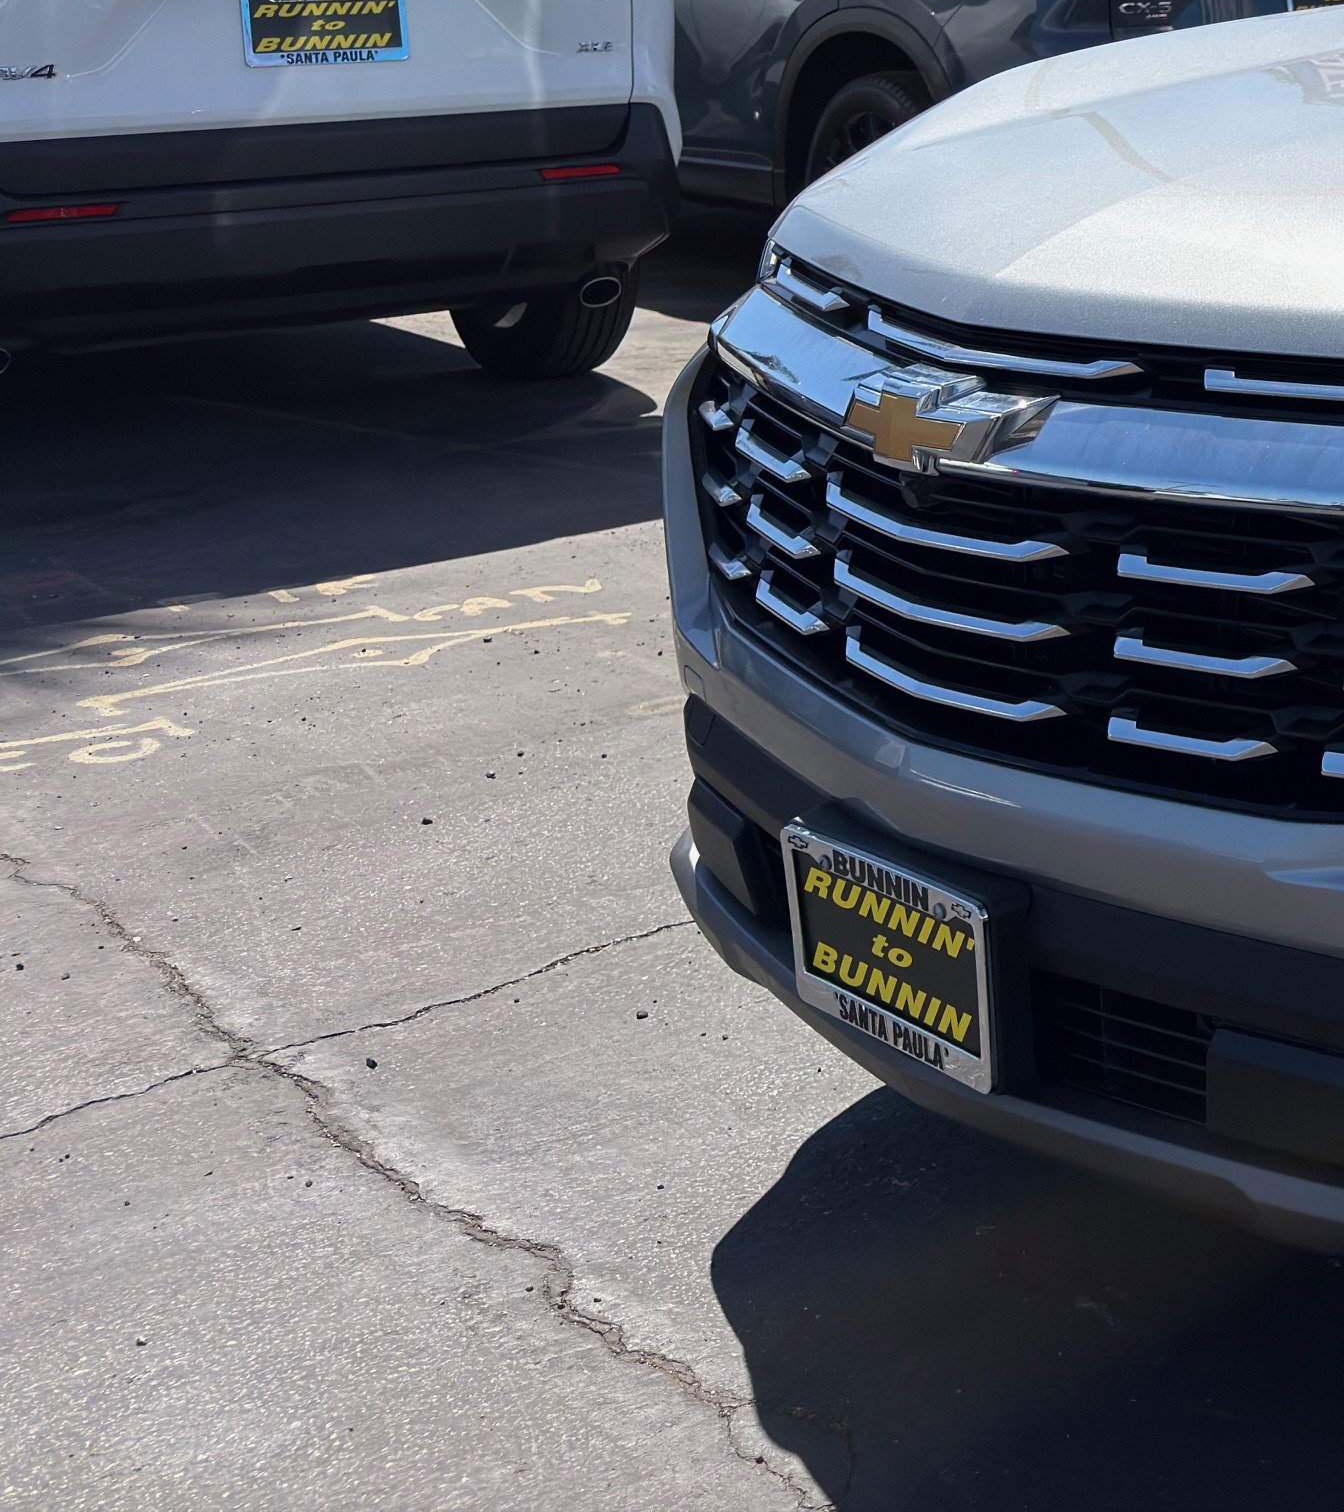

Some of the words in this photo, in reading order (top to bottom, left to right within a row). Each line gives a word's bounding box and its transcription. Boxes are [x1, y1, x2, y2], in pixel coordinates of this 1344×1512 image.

[253, 0, 396, 19] RUNNIN'
[310, 19, 346, 31] to
[255, 32, 392, 53] BUNNIN
[286, 51, 327, 65] SANTA
[333, 49, 375, 63] PAULA
[831, 849, 930, 912] BUNNIN
[803, 867, 976, 959] RUNNIN'
[871, 934, 913, 968] to
[812, 941, 973, 1043] BUNNIN
[838, 993, 889, 1042] SANTA
[893, 1021, 945, 1071] PAULA
